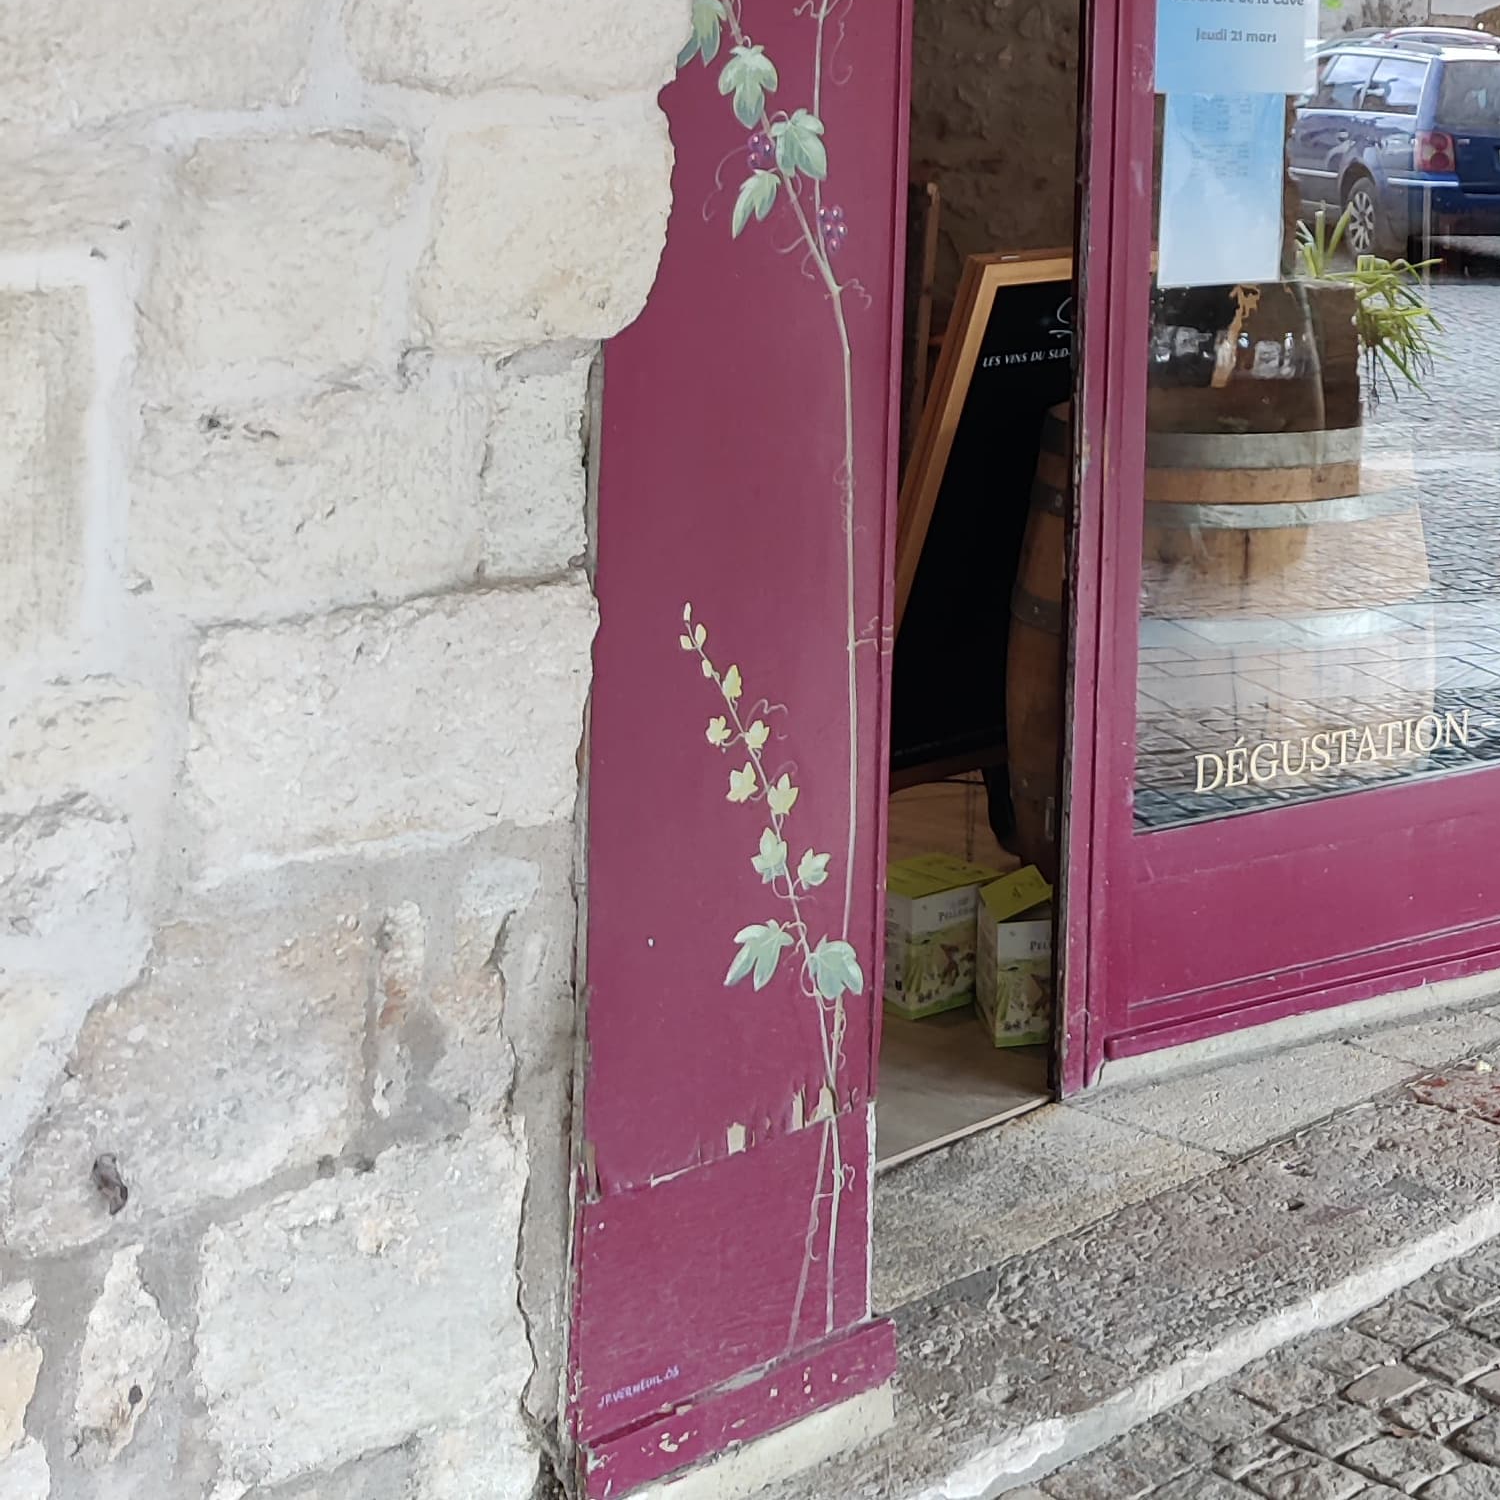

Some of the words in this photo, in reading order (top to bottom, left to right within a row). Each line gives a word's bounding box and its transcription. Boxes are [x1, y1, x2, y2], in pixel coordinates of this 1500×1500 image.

[1196, 27, 1228, 42] Jeudi
[1231, 30, 1243, 42] 21
[1246, 31, 1277, 43] mars
[982, 355, 1001, 368] LES
[1005, 352, 1028, 364] VINS
[1030, 350, 1046, 362] DU
[1194, 708, 1471, 794] DÉGUSTATION
